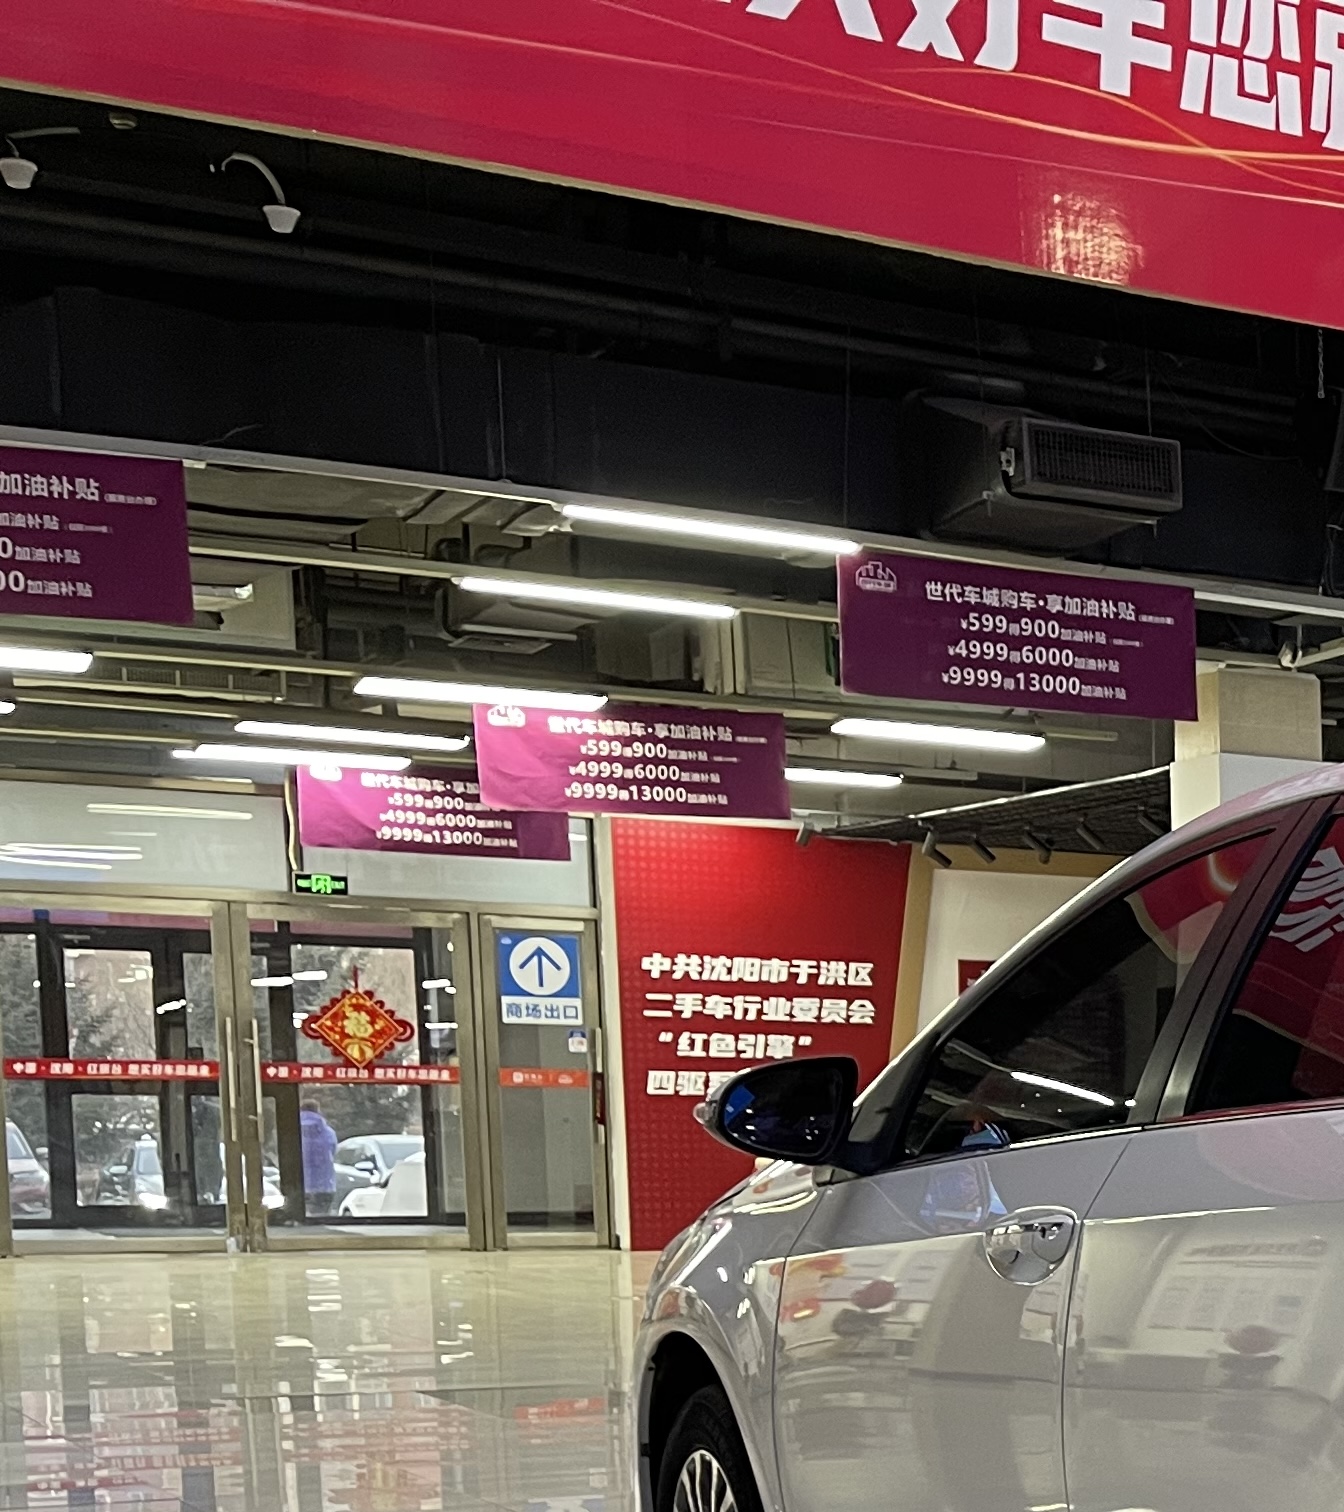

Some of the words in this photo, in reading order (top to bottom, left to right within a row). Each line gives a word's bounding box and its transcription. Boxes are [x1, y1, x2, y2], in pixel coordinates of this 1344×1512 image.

[641, 953, 875, 986] 中共沈阳市于洪区
[505, 1002, 579, 1020] 商场出口
[642, 993, 875, 1025] 二手车行业委员会
